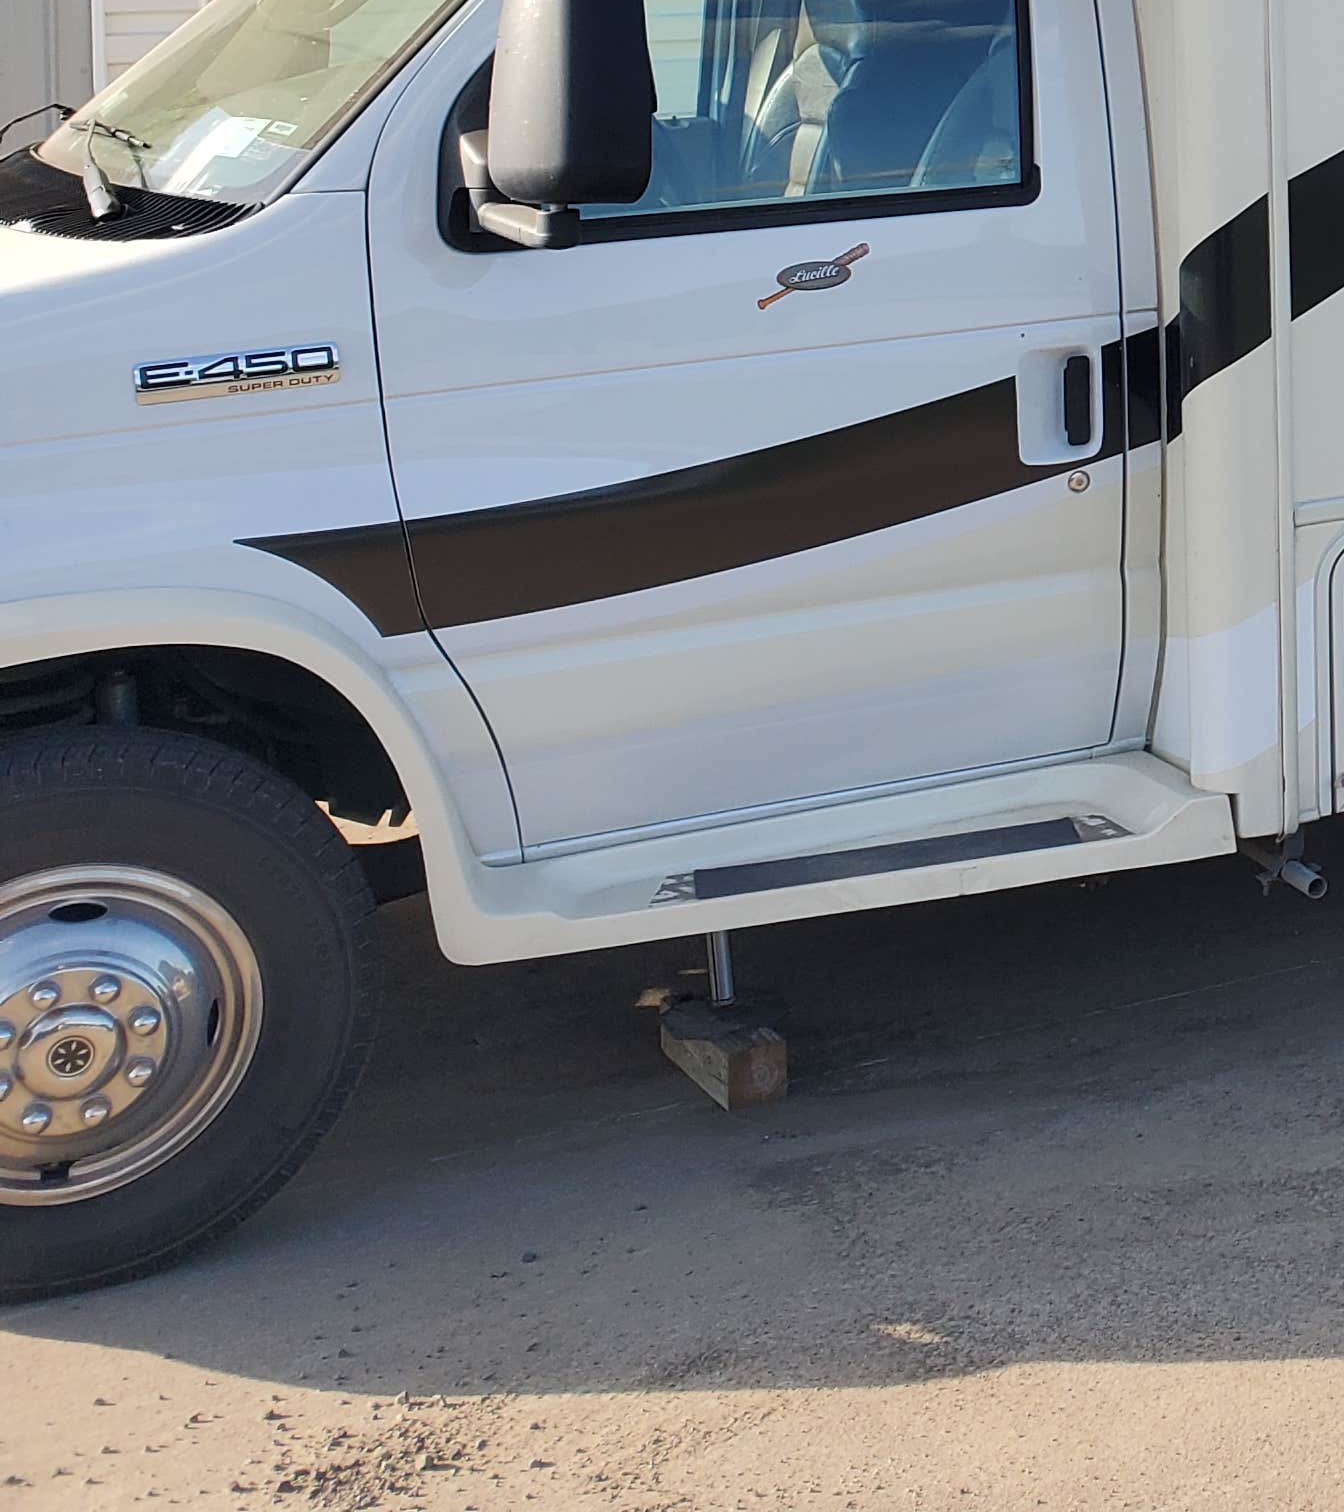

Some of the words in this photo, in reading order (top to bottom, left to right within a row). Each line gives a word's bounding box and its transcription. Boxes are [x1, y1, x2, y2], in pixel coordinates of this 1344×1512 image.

[788, 264, 840, 284] Lucille
[139, 345, 335, 390] E-450
[227, 379, 284, 394] SUPER
[289, 373, 334, 387] DUTY
